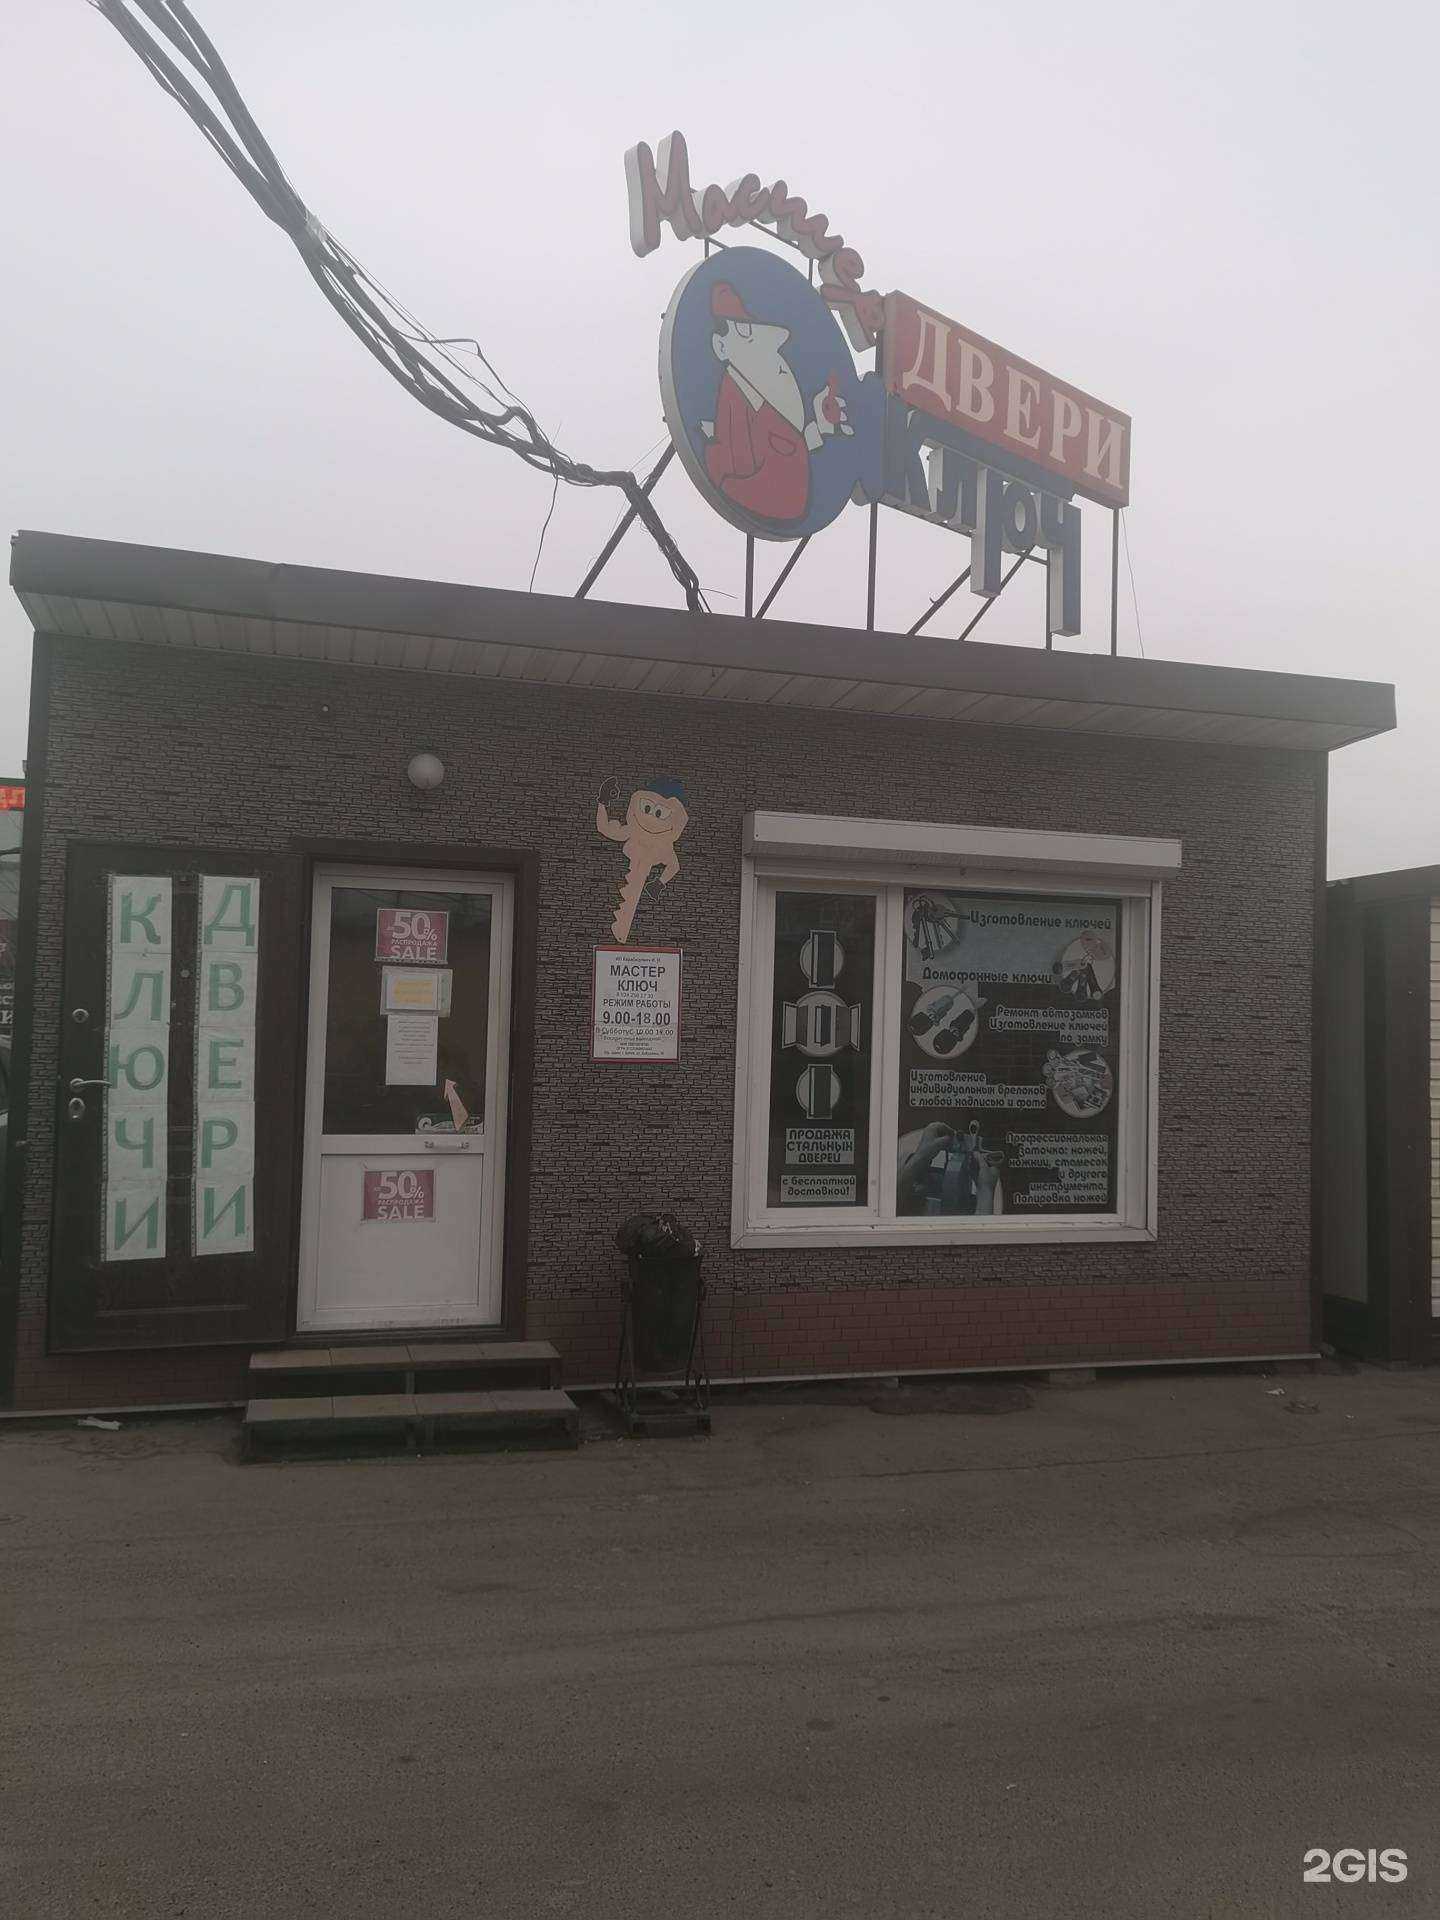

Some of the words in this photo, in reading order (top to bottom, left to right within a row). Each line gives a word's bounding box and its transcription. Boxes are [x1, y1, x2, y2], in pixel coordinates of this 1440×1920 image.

[902, 307, 1126, 490] ДВЕРИ
[886, 405, 1082, 636] КЛЮЧ
[970, 910, 1062, 928] Изготовление
[1065, 917, 1111, 930] ключей
[390, 945, 437, 961] SALE
[610, 964, 666, 978] МАСТЕР
[922, 966, 1009, 985] Домофонные
[1012, 972, 1052, 984] ключи
[618, 979, 658, 992] КЛЮЧ
[603, 998, 634, 1008] РЕЖИМ
[635, 999, 671, 1009] РАБОТЫ
[602, 1010, 671, 1026] 9.00-18.00
[997, 1006, 1039, 1018] Ремонт
[1042, 1007, 1108, 1021] автозамков
[990, 1018, 1066, 1031] Изготовление
[1060, 1033, 1072, 1042] по
[202, 882, 256, 1239] ДВЕРИ
[111, 890, 165, 1252] КЛЮЧИ
[910, 1070, 987, 1084] Изготовление
[910, 1084, 995, 1097] индивидуальных
[997, 1084, 1046, 1096] брелоков
[918, 1096, 953, 1106] любой
[955, 1096, 1005, 1107] надписью
[1016, 1099, 1047, 1109] фото
[789, 1129, 851, 1140] ПРОДАЖА
[786, 1140, 853, 1152] СТАЛЬНЫХ
[791, 1176, 856, 1186] бесплатной
[787, 1186, 850, 1196] доставкой!
[377, 1204, 425, 1220] SALE
